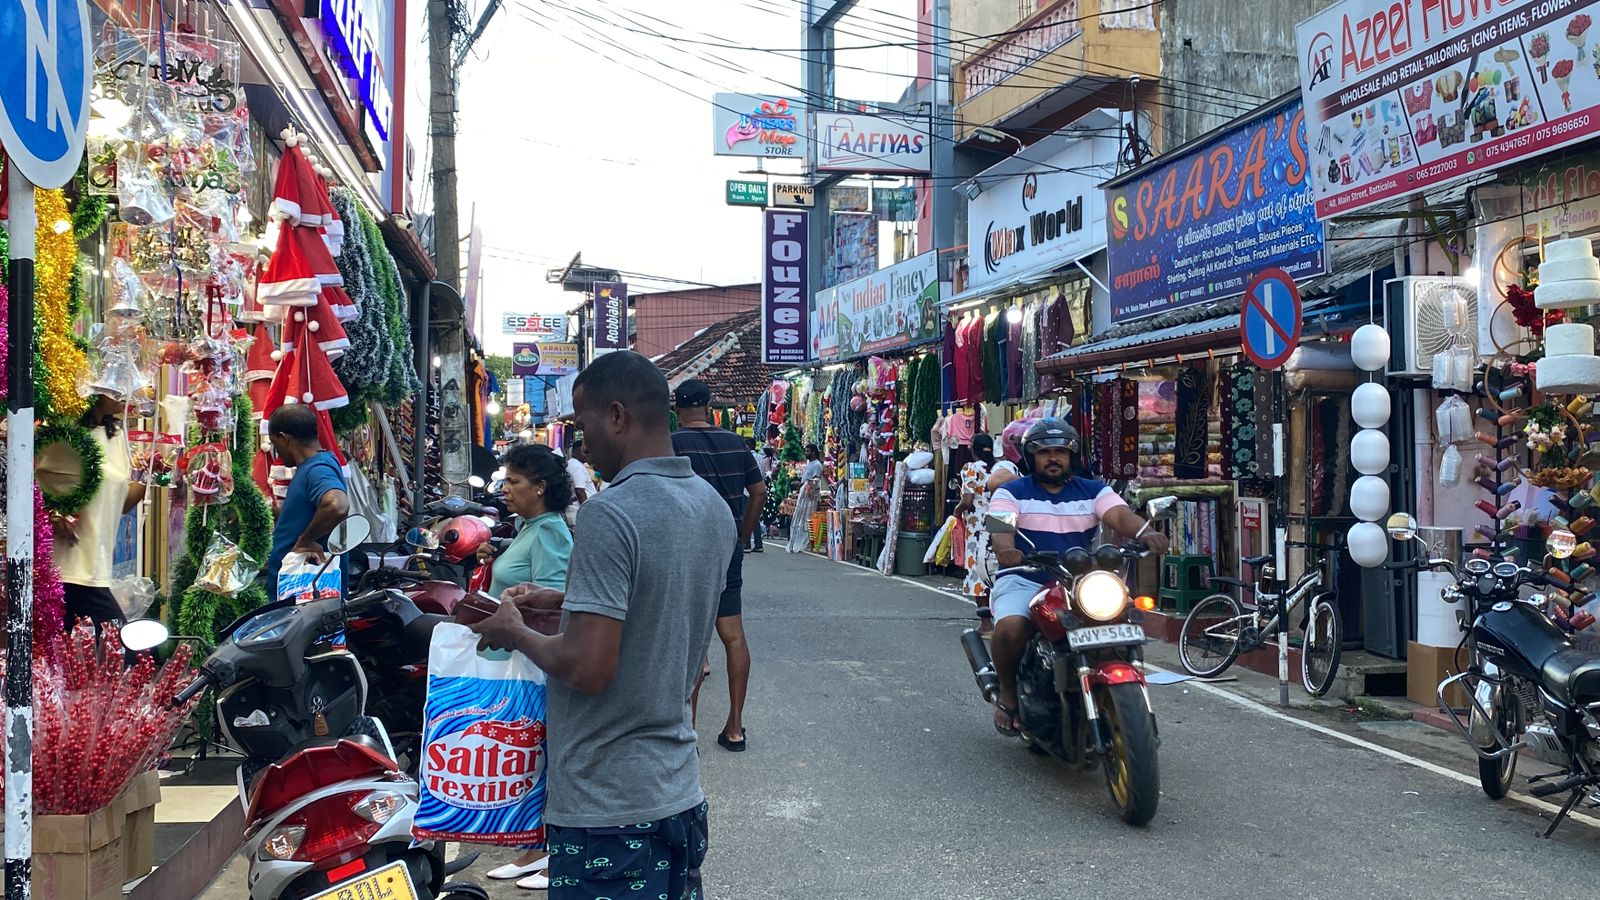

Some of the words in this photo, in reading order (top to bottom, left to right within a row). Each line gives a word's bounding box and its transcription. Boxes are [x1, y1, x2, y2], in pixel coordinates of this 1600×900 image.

[1340, 82, 1381, 107] WHOLESALE
[1381, 71, 1398, 89] AND
[1399, 59, 1424, 80] RETAIL
[1425, 40, 1470, 68] TAILORING,
[1471, 25, 1497, 49] ICING
[1499, 12, 1529, 36] ITEMS,
[765, 146, 793, 155] STORE
[836, 132, 924, 154] AAFIYAS
[1486, 144, 1499, 158] 075
[1500, 134, 1531, 153] 4347657
[1536, 127, 1551, 141] 075
[1552, 115, 1590, 137] 9696650
[730, 183, 746, 193] OPEN
[748, 184, 766, 194] DAILY
[777, 184, 813, 194] PARKING
[1133, 109, 1308, 242] SAARA'S
[1416, 168, 1429, 181] 065
[1258, 205, 1274, 221] out
[1275, 192, 1287, 221] of
[1338, 194, 1350, 206] Main
[1029, 195, 1082, 247] World
[1202, 247, 1214, 260] Rich
[1215, 242, 1234, 258] Quality
[1259, 228, 1280, 243] Blouse
[1214, 258, 1226, 271] Kind
[1253, 247, 1270, 261] Frock
[1270, 240, 1299, 256] Materials
[1301, 234, 1317, 247] ETC.
[853, 279, 886, 313] Indian
[890, 268, 928, 300] Fancy
[507, 316, 561, 329] ESSTEE
[605, 295, 619, 344] Robbialac
[428, 743, 543, 778] Sattar
[428, 774, 534, 803] Textiles
